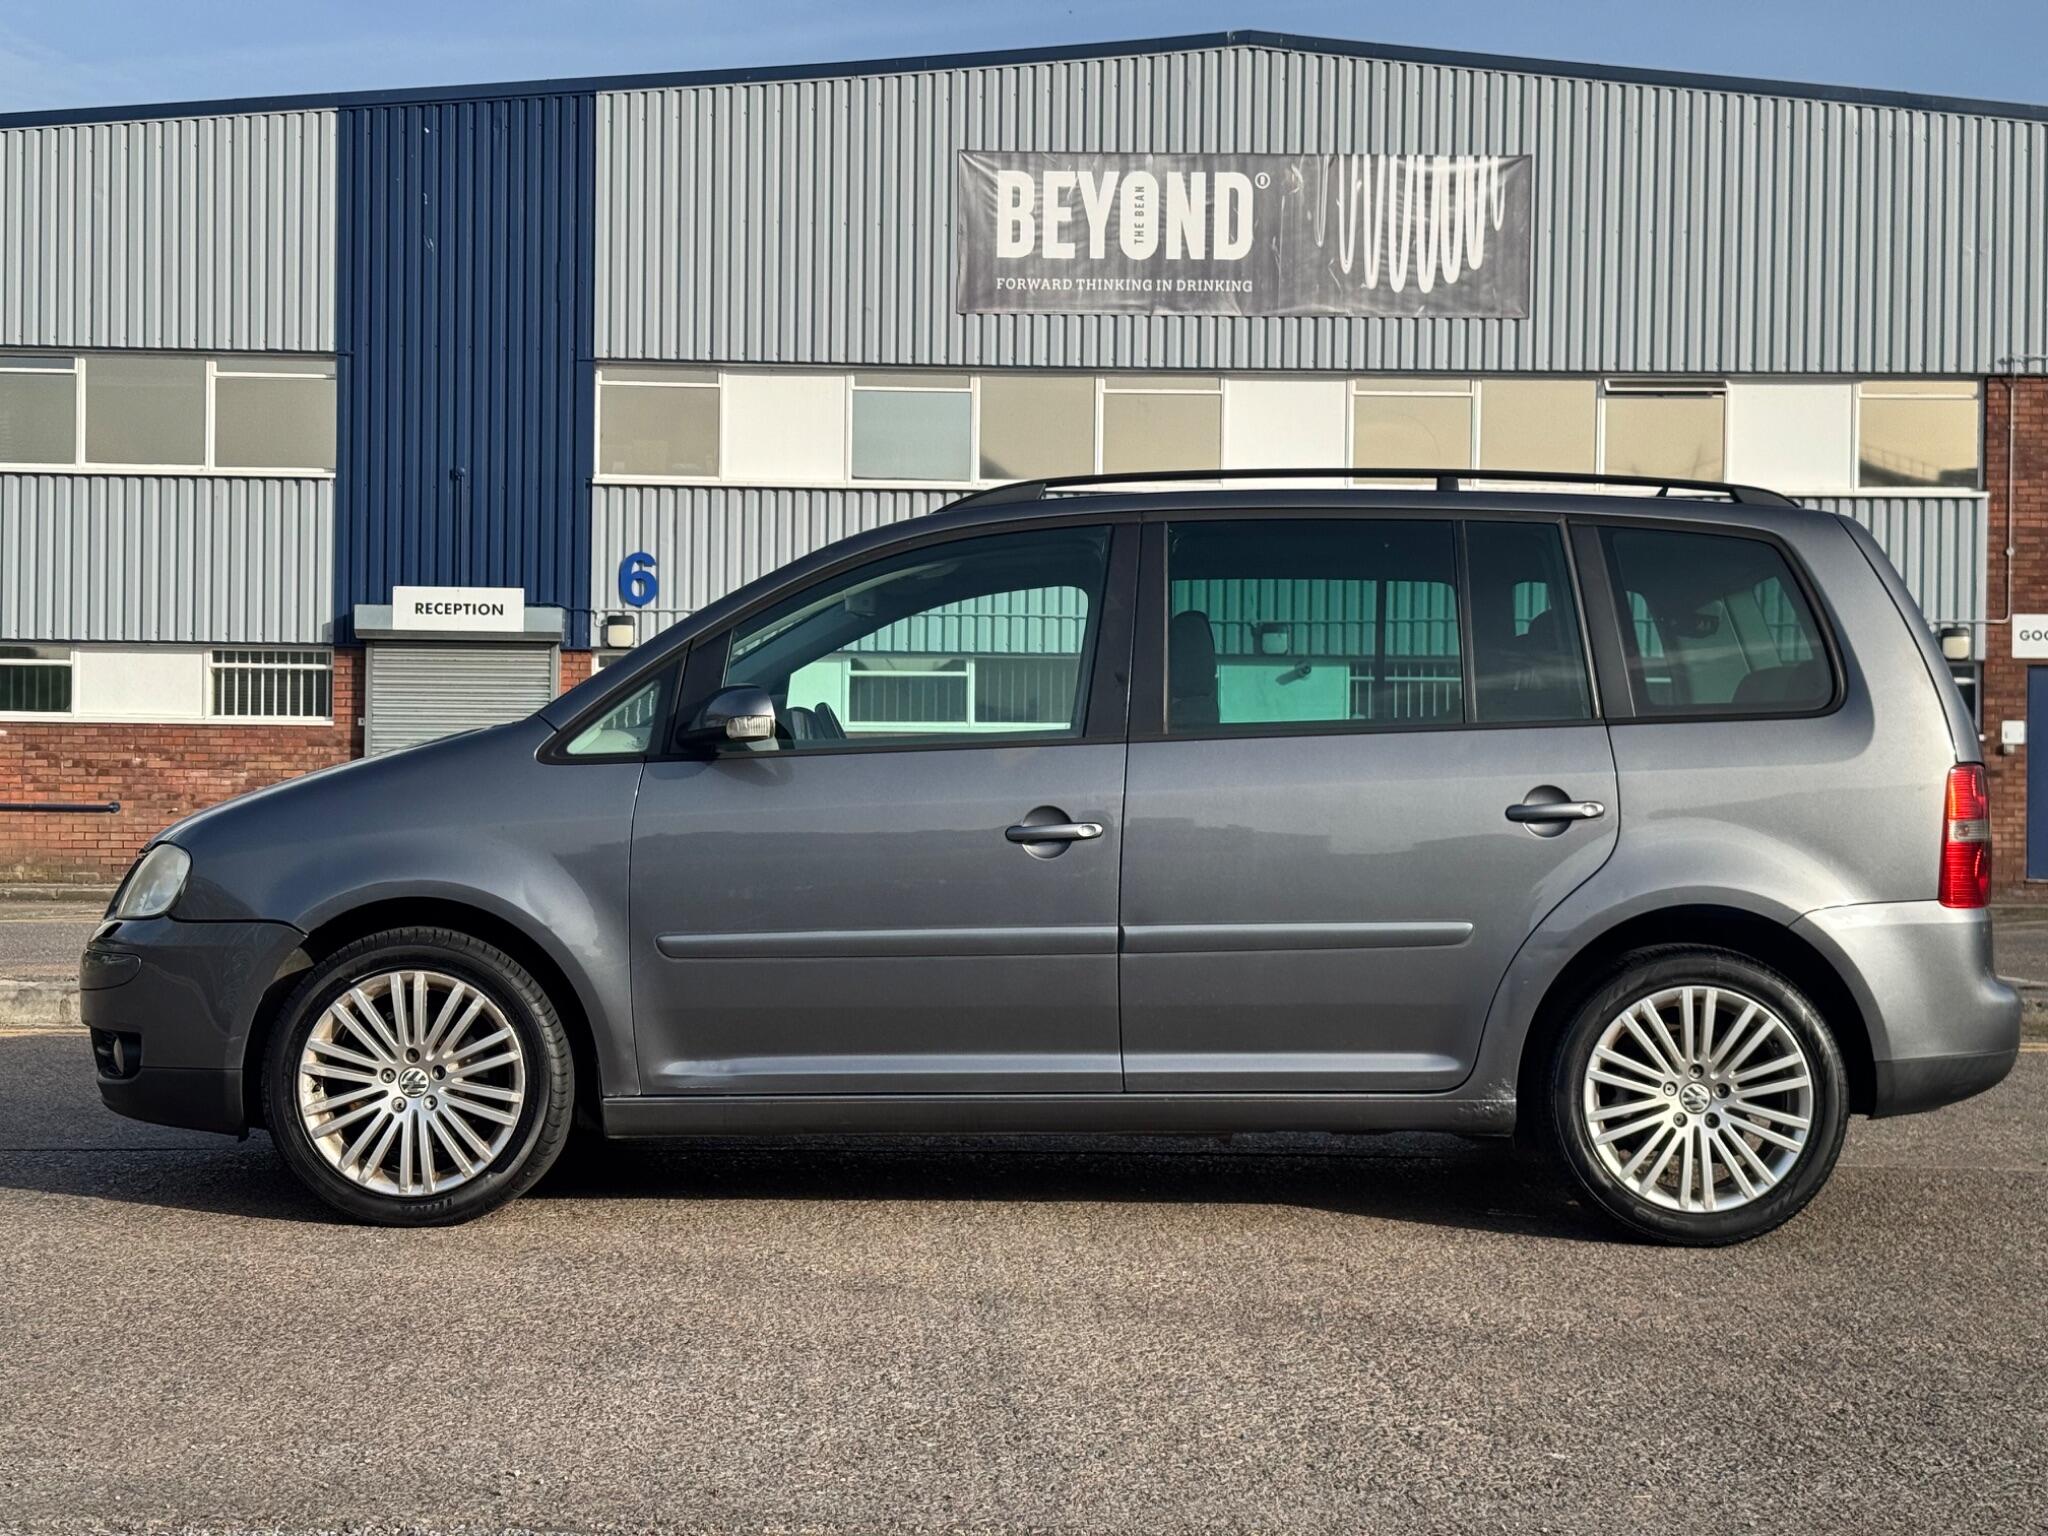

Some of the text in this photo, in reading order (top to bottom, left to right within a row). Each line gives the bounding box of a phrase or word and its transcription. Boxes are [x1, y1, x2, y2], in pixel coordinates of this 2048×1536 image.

[996, 170, 1254, 260] BEYOND
[1134, 186, 1145, 245] THE BEAN
[996, 277, 1254, 293] FORWARD THINKING IN DRINKING
[618, 551, 657, 608] 6
[415, 602, 504, 616] RECEPTION
